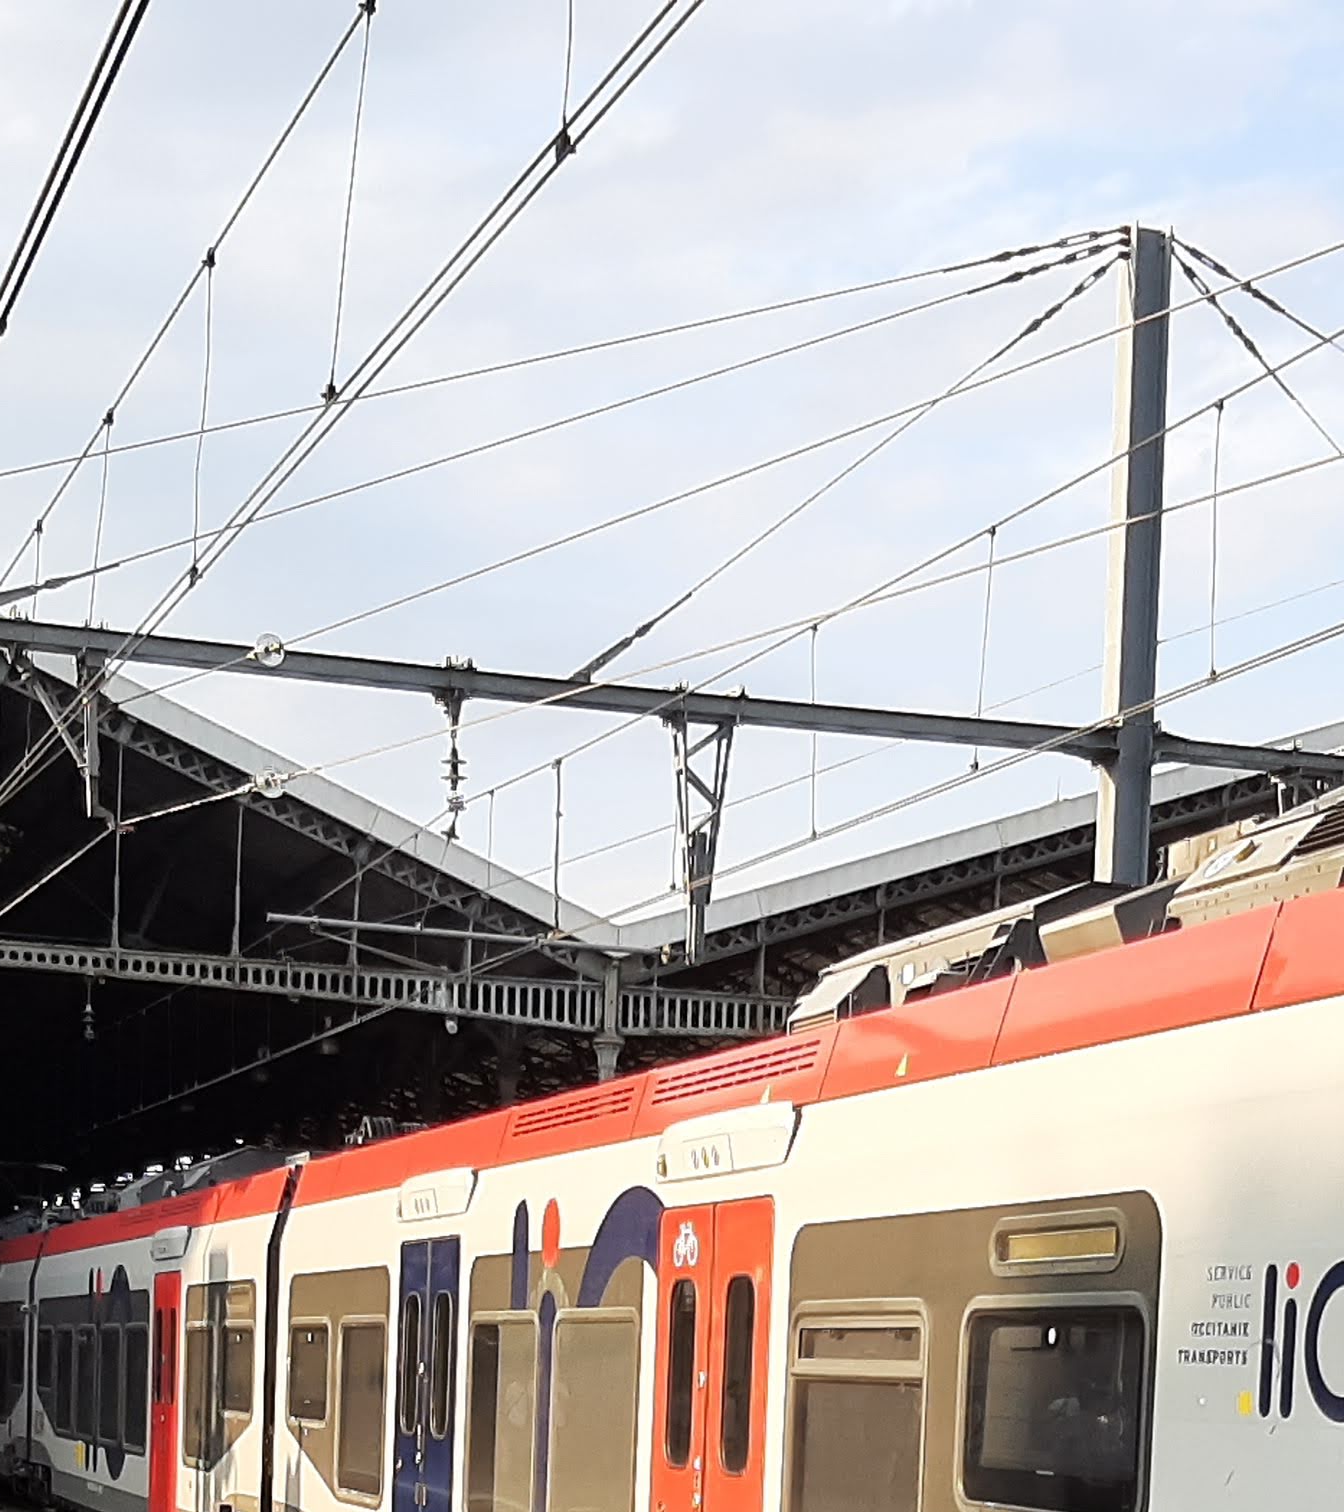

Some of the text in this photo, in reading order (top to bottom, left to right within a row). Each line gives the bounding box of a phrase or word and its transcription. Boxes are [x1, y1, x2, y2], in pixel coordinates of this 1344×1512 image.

[1206, 1265, 1252, 1281] SERVICE
[1211, 1293, 1252, 1309] PUBLIC
[1190, 1321, 1250, 1337] OCCITANIE
[1177, 1349, 1248, 1365] TRANSPORTS
